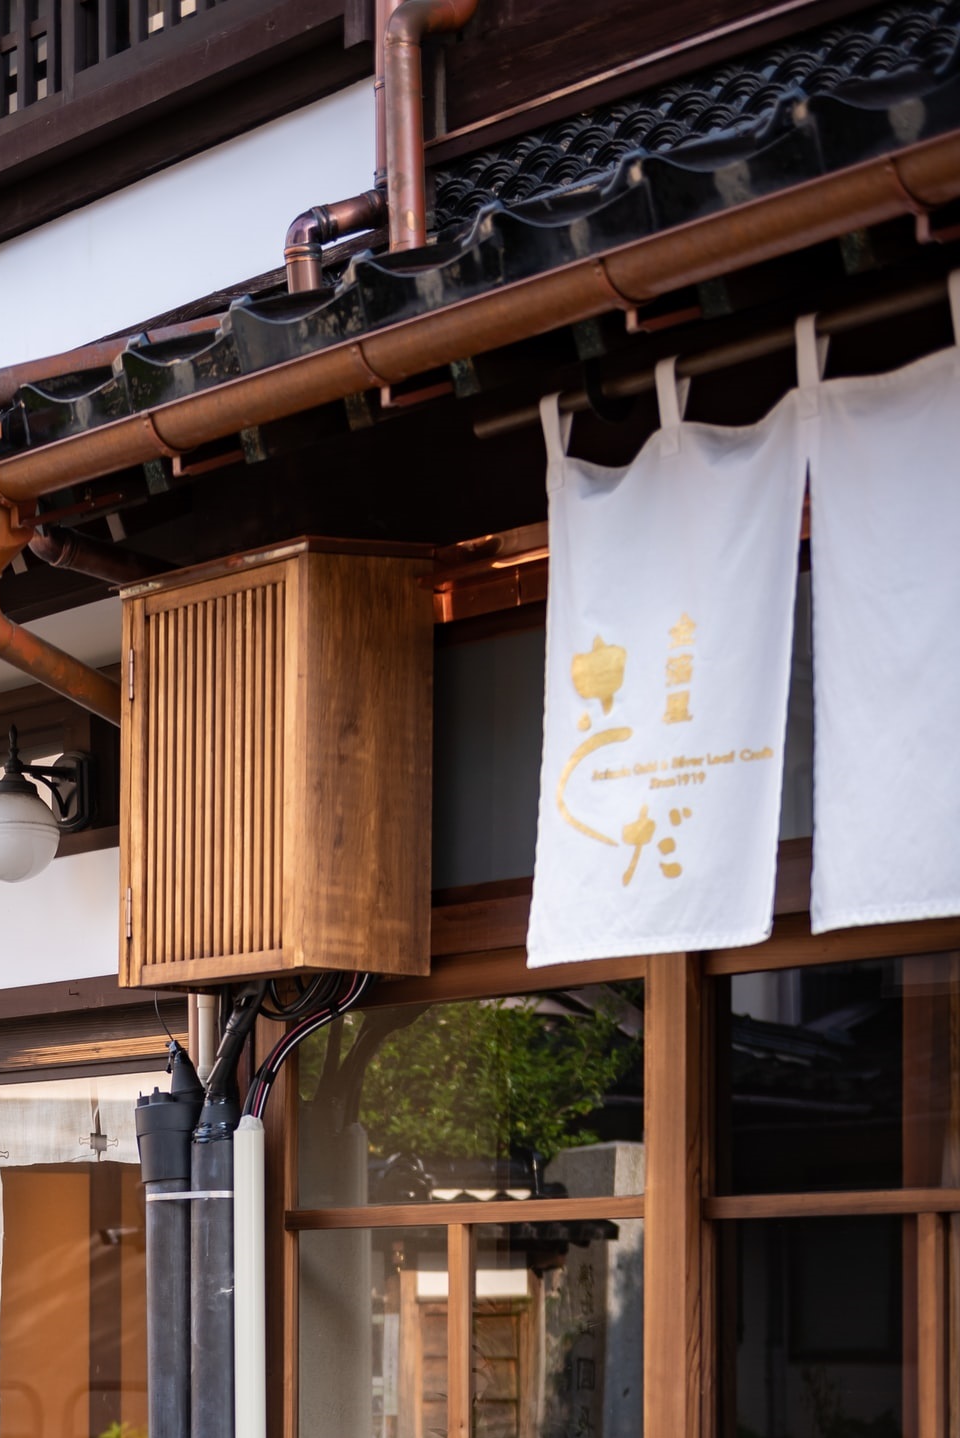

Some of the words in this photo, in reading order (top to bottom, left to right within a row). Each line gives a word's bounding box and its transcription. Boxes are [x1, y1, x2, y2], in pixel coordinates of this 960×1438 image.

[671, 755, 704, 769] Silver
[706, 751, 735, 765] Leaf
[739, 746, 774, 762] Craft
